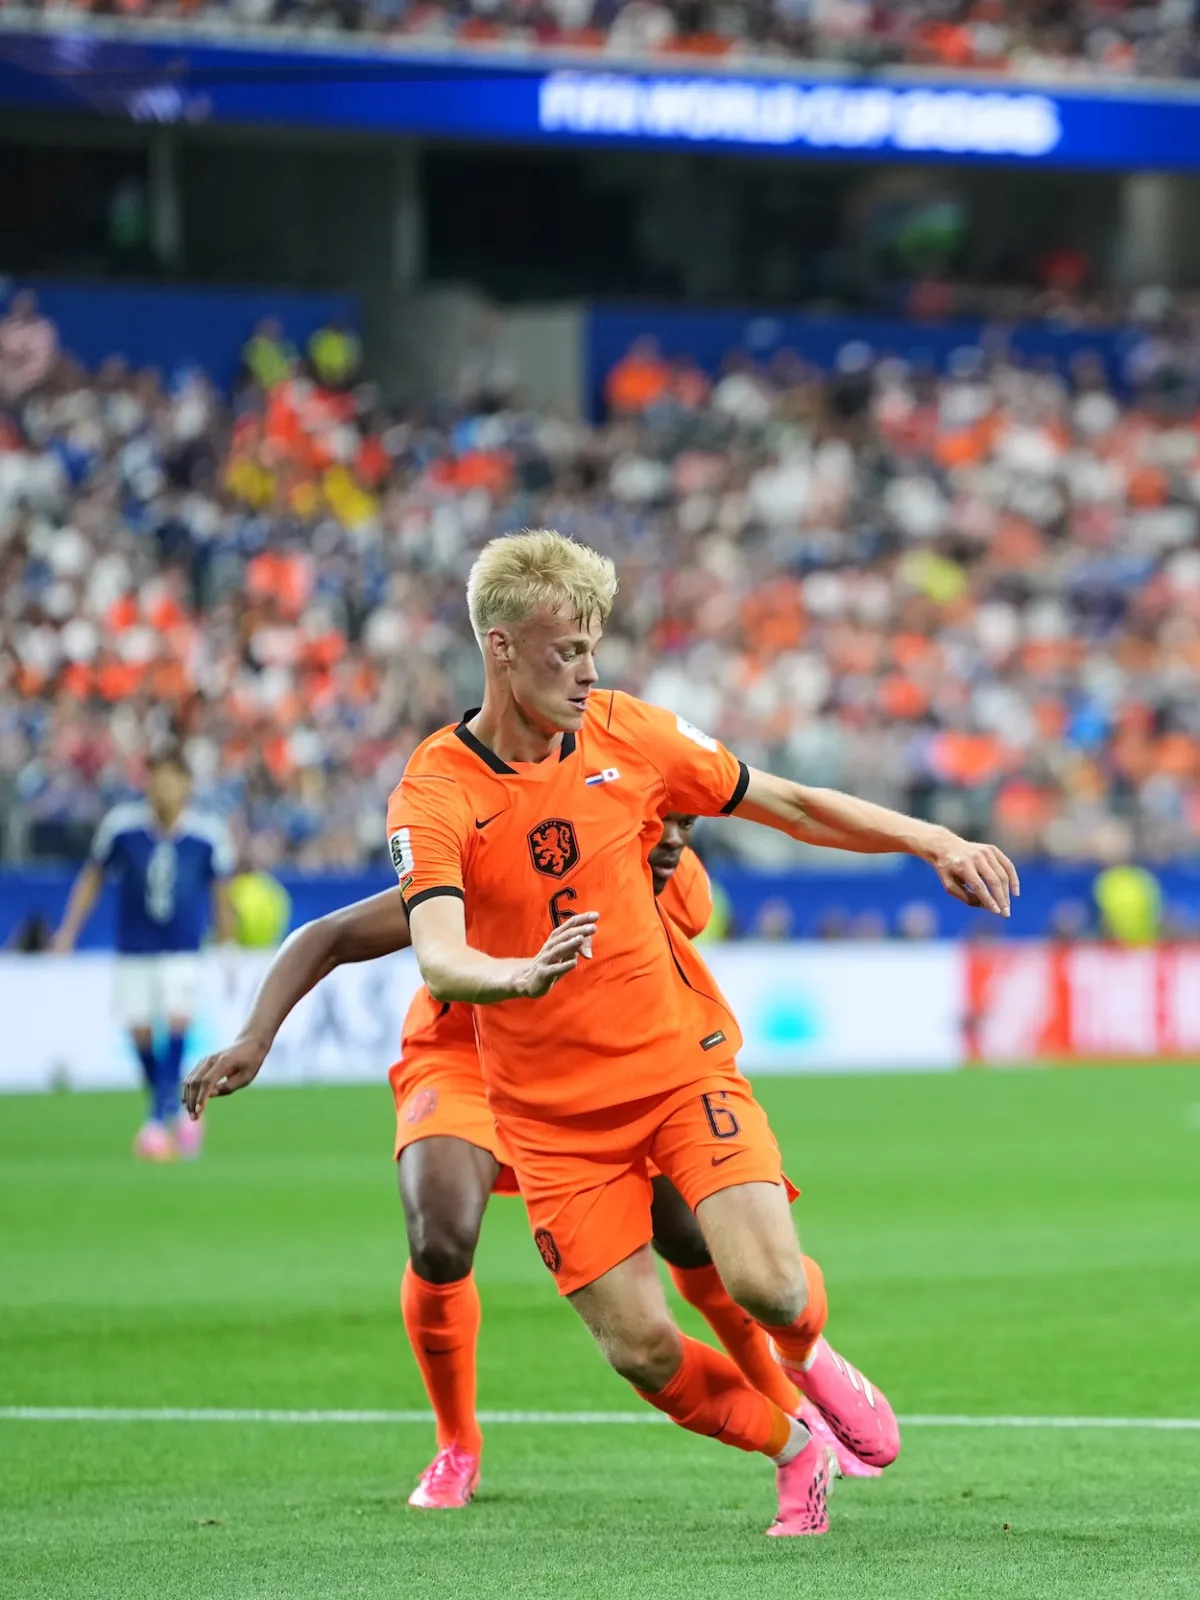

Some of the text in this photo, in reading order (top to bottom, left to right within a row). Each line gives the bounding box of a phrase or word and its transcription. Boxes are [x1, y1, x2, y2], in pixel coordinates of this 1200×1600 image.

[539, 72, 638, 134] FIFA
[645, 76, 801, 144] WORLD
[802, 83, 893, 148] CUP
[700, 1091, 741, 1140] 6
